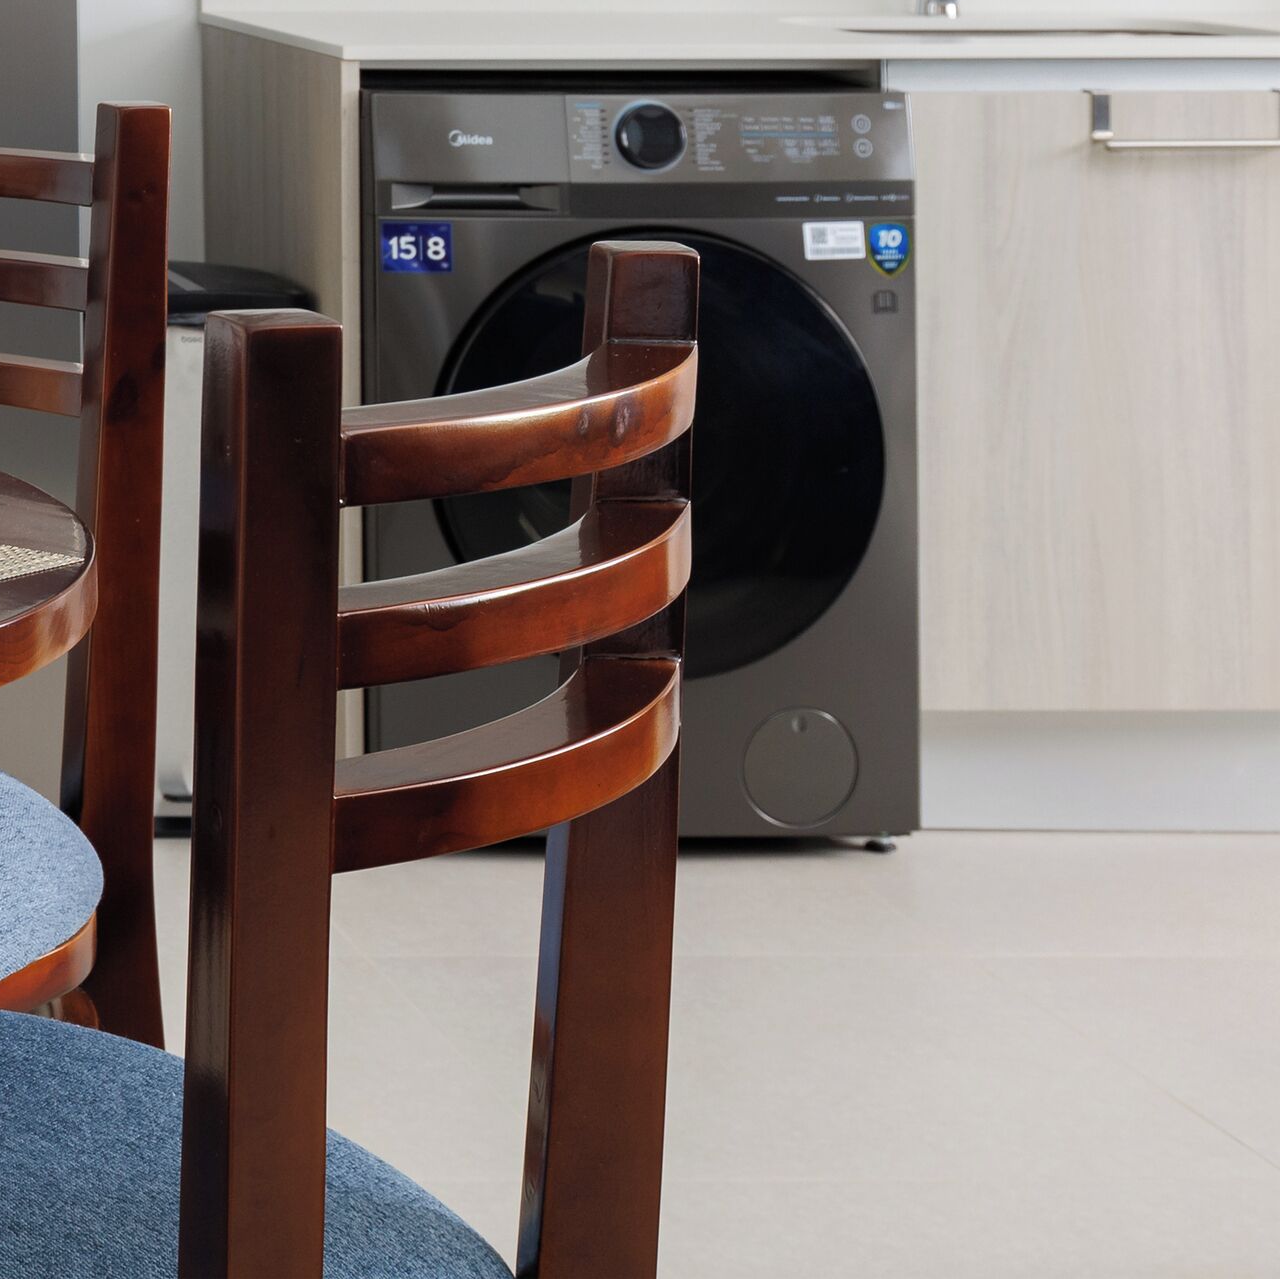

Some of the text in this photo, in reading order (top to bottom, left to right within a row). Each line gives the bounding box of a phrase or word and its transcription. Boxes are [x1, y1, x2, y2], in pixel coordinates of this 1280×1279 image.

[450, 131, 493, 146] Midea
[388, 235, 446, 261] 15 8
[878, 229, 903, 248] 10
